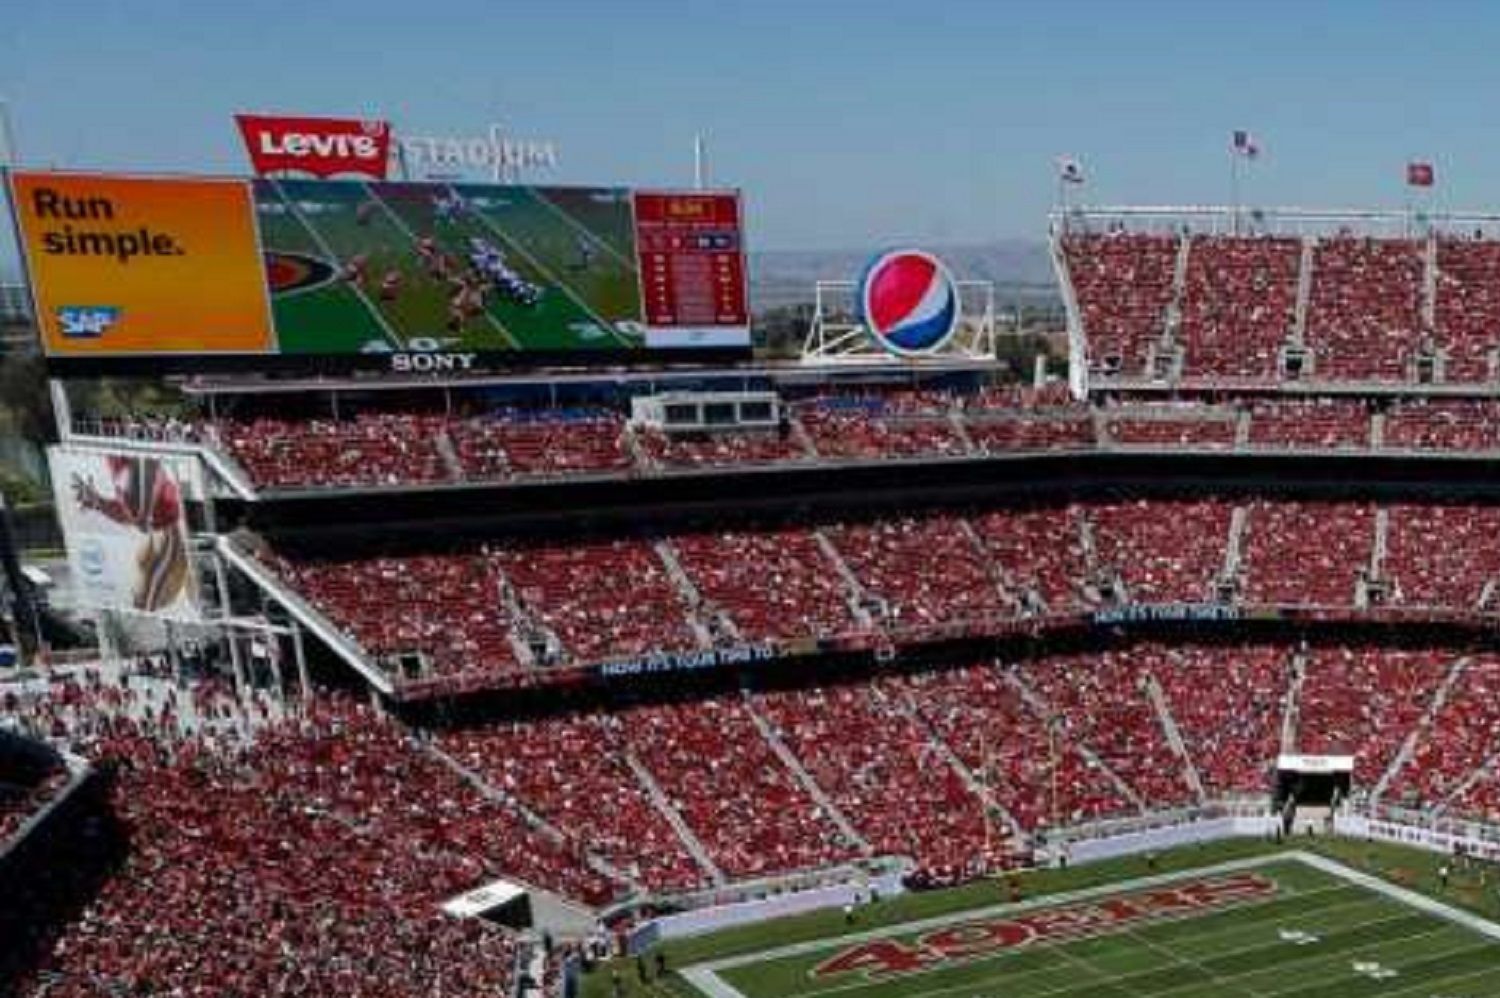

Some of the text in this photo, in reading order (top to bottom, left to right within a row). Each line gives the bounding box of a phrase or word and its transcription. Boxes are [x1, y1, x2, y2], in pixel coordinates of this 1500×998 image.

[32, 187, 115, 220] Run
[42, 224, 187, 264] simple.
[58, 309, 118, 335] SAP
[390, 353, 477, 372] SONY
